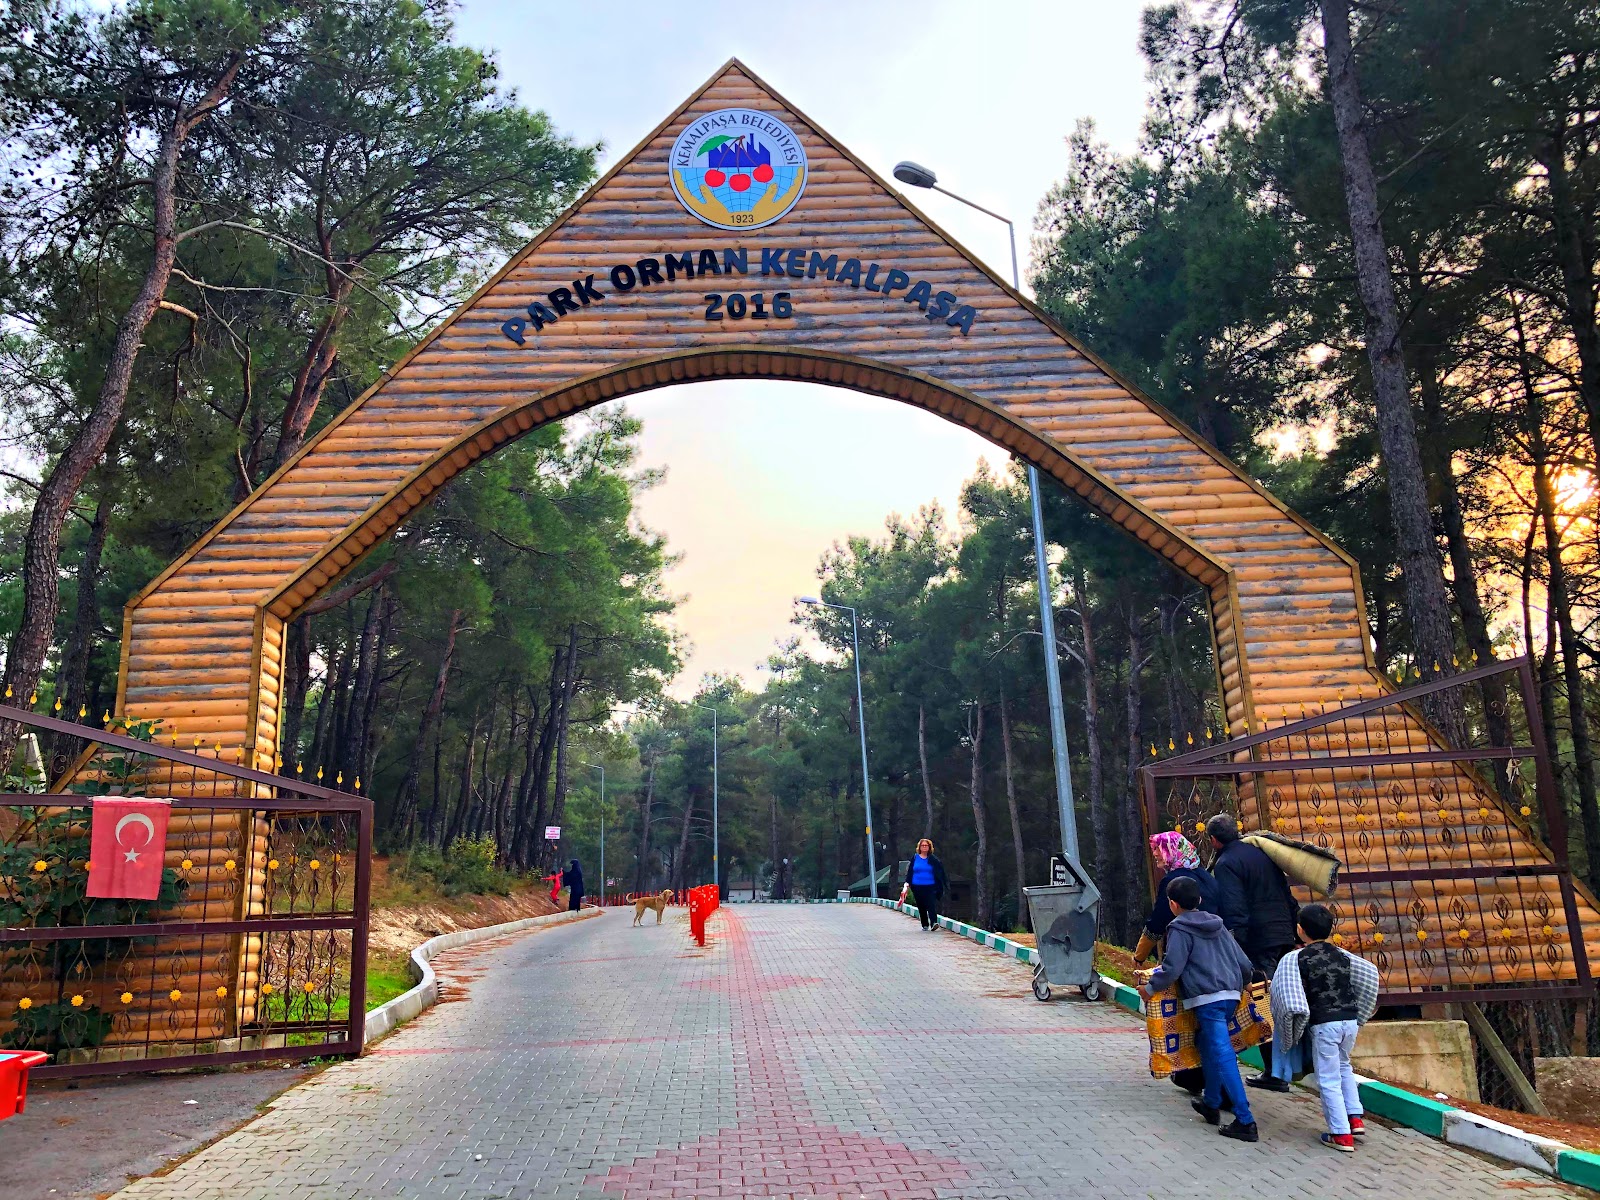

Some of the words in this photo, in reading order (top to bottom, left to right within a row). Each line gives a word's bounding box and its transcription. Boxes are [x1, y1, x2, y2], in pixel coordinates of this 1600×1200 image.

[676, 113, 737, 167] KEMALPAŞA
[741, 113, 803, 166] BELEDİYESİ
[730, 214, 754, 224] 1923
[501, 273, 605, 346] PARK
[610, 247, 748, 291] ORMAN
[761, 247, 977, 336] KEMALPAŞA
[704, 292, 793, 321] 2016
